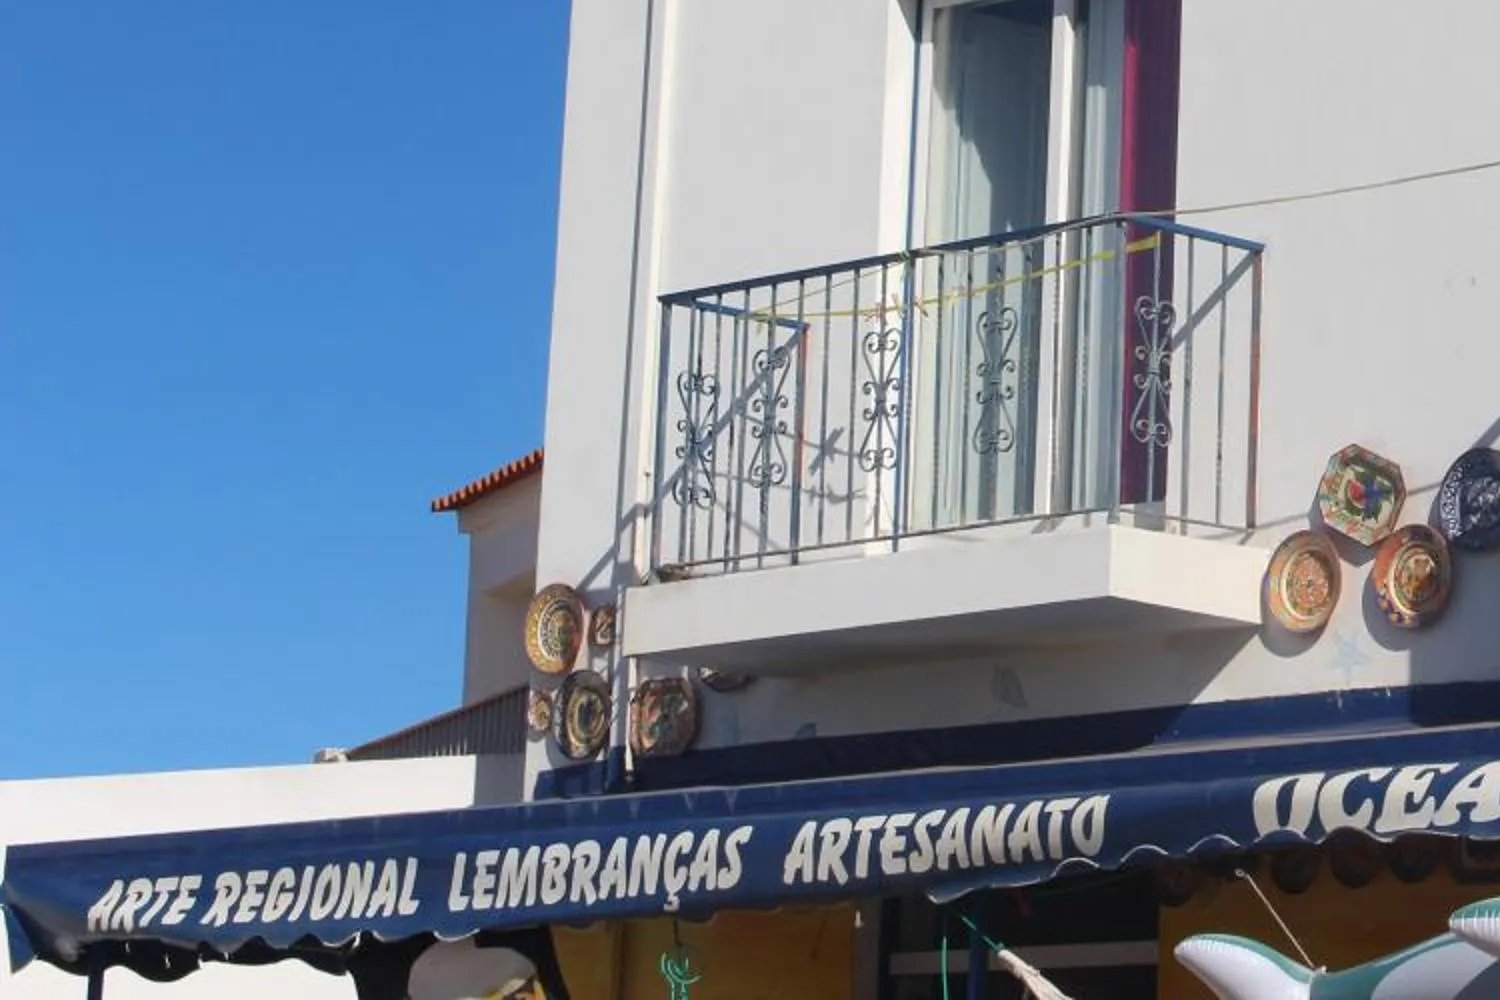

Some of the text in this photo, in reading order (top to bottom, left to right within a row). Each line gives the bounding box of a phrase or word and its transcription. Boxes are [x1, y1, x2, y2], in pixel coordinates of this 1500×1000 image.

[87, 875, 202, 933] ARTE
[201, 857, 420, 927] REGIONAL
[447, 825, 754, 911] LEMBRANÇAS
[783, 794, 1110, 886] ARTESANATO
